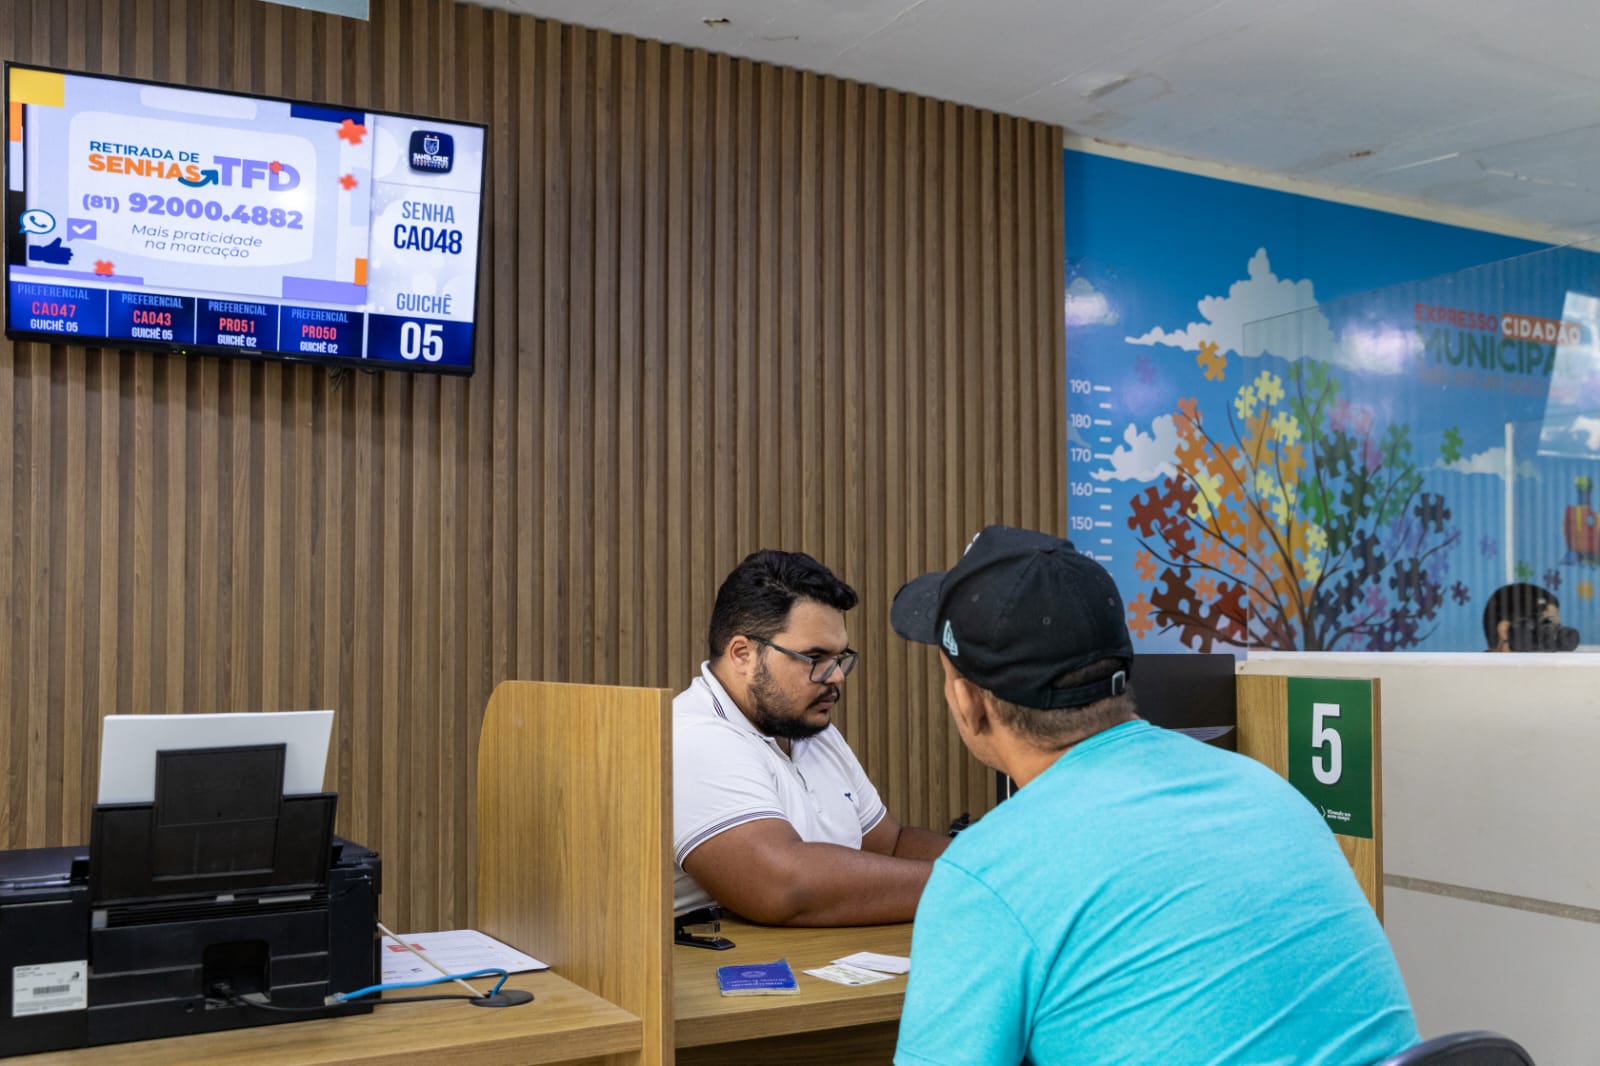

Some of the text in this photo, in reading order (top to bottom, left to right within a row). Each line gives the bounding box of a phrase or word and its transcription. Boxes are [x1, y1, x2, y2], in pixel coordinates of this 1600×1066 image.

[90, 140, 200, 163] RETIRADA DE
[88, 153, 300, 192] SENHAS TFD
[82, 192, 303, 230] (81) 92000.4882
[402, 200, 455, 224] SENHA
[132, 224, 263, 248] Mais praticidade
[394, 224, 462, 255] CA048
[145, 239, 250, 259] na marcação
[18, 283, 90, 300] PREFERENCIAL
[121, 292, 183, 308] PREFERENCIAL
[208, 300, 267, 316] PREFERENCIAL
[396, 292, 452, 315] GUICHÊ
[32, 300, 76, 318] CA047
[291, 308, 349, 323] PREFERENCIAL
[30, 318, 78, 332] GUICHÊ 05
[133, 310, 172, 326] CA043
[219, 317, 255, 333] PR051
[1414, 303, 1580, 344] EXPRESSO CIDADÃO
[131, 326, 173, 341] GUICHÊ 05
[302, 324, 337, 340] PR050
[217, 334, 257, 348] GUICHÊ 02
[300, 340, 338, 354] GUICHÊ 02
[400, 321, 444, 362] 05
[1070, 379, 1092, 394] 190
[1070, 414, 1092, 428] 180
[1071, 448, 1092, 463] 170
[1071, 482, 1093, 496] 160
[1071, 516, 1093, 531] 150
[1312, 702, 1342, 784] 5
